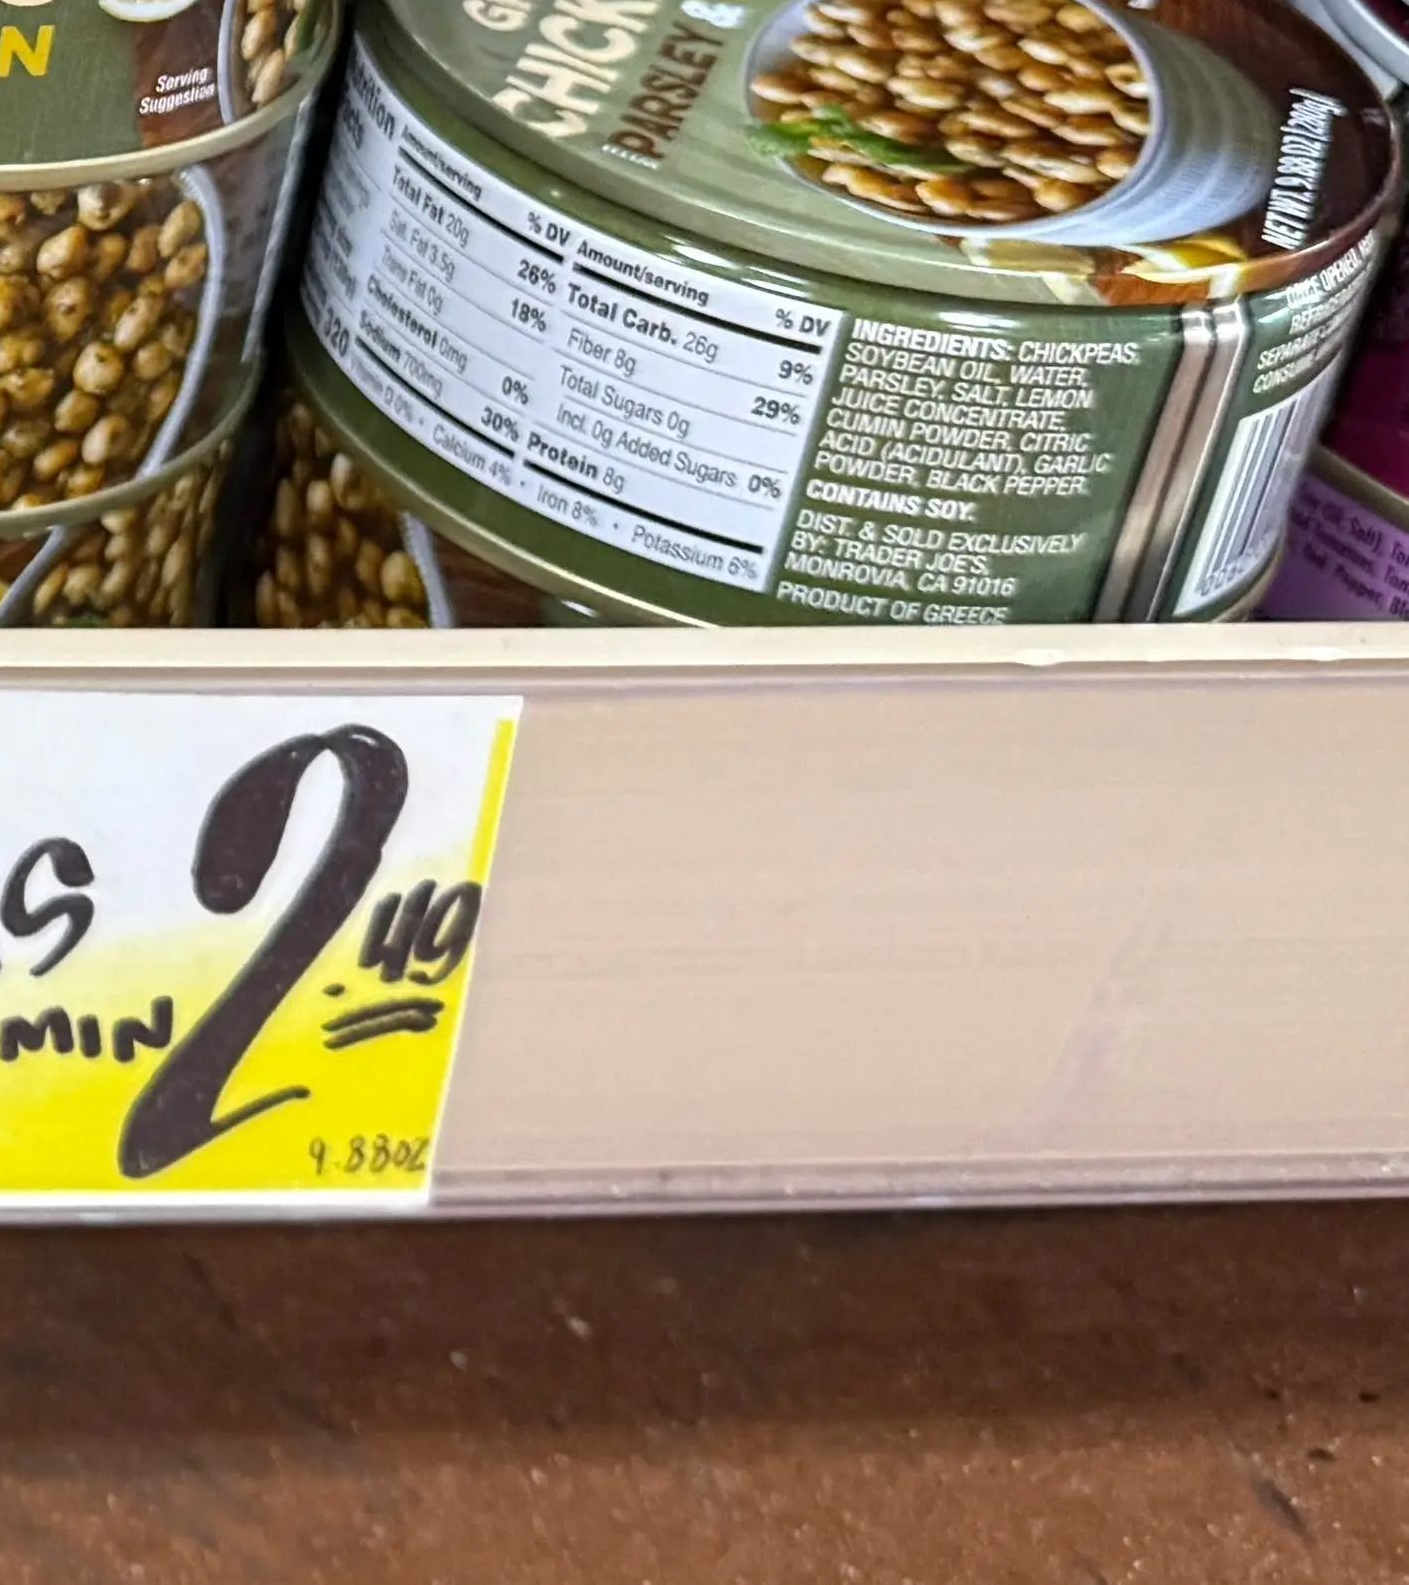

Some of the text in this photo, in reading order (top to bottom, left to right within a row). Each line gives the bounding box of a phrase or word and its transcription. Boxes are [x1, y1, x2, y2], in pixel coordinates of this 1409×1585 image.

[155, 66, 210, 95] Serving
[138, 82, 216, 117] Suggestion
[517, 259, 557, 295] 26%
[576, 239, 831, 337] Amount/serving DV
[510, 298, 547, 333] 18%
[567, 283, 814, 385] Total Carb. 26g 9%
[851, 317, 1014, 361] INGREDIENTS:
[568, 327, 800, 426] Fiber 8g 29%
[844, 342, 952, 379] SOYBEAN
[502, 375, 529, 406] 0%
[560, 366, 690, 439] Total Sugars 0g
[831, 387, 900, 416] JUICE
[1015, 387, 1095, 410] LEMON
[481, 407, 520, 443] 30%
[825, 409, 1093, 453] CUMIN CITRIC
[526, 431, 626, 495] Protein 8g
[616, 431, 781, 500] Added Sugars 0%
[819, 431, 1112, 474] ACID GARLIC
[805, 479, 921, 516] CONTAINS
[926, 470, 1002, 494] BLACK
[834, 539, 922, 570] TRADER
[859, 521, 880, 543] &
[882, 523, 944, 550] SOLD
[948, 532, 1088, 557] EXCLUSIVELY
[776, 581, 1008, 625] PRODUCT OF GREECE
[917, 573, 1018, 599] CA 91016
